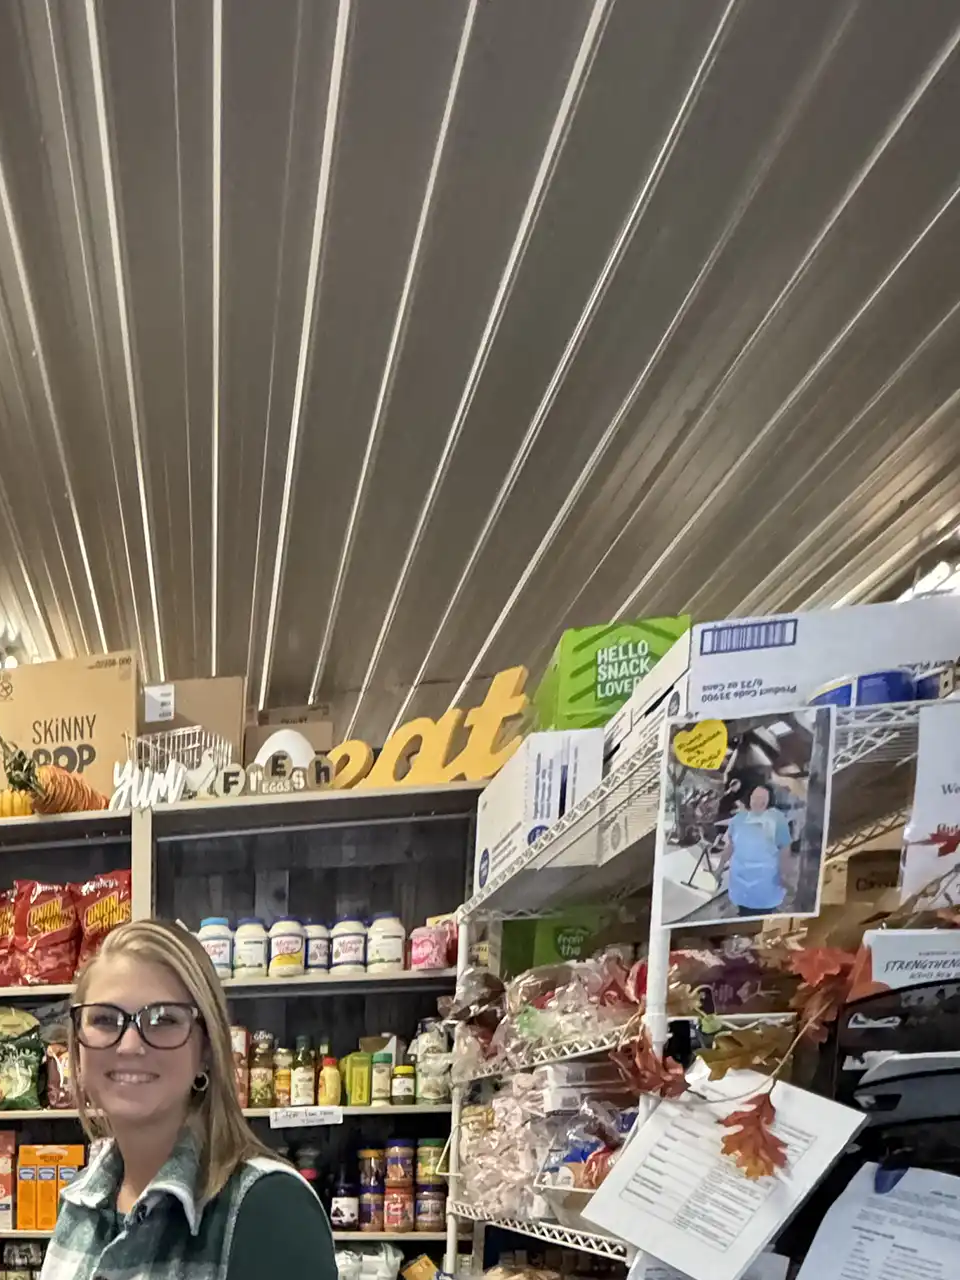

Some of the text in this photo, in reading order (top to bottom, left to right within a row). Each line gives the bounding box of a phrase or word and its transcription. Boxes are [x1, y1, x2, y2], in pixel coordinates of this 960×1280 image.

[597, 640, 648, 665] HELLO
[597, 656, 651, 682] SNACK
[733, 690, 757, 699] Code
[760, 685, 797, 696] Product
[328, 665, 529, 790] eat
[32, 744, 96, 774] POP
[109, 757, 187, 811] yum
[30, 899, 60, 925] ONION
[87, 894, 117, 925] ONION
[102, 902, 131, 930] RINGS
[557, 934, 584, 945] from
[560, 944, 581, 956] the
